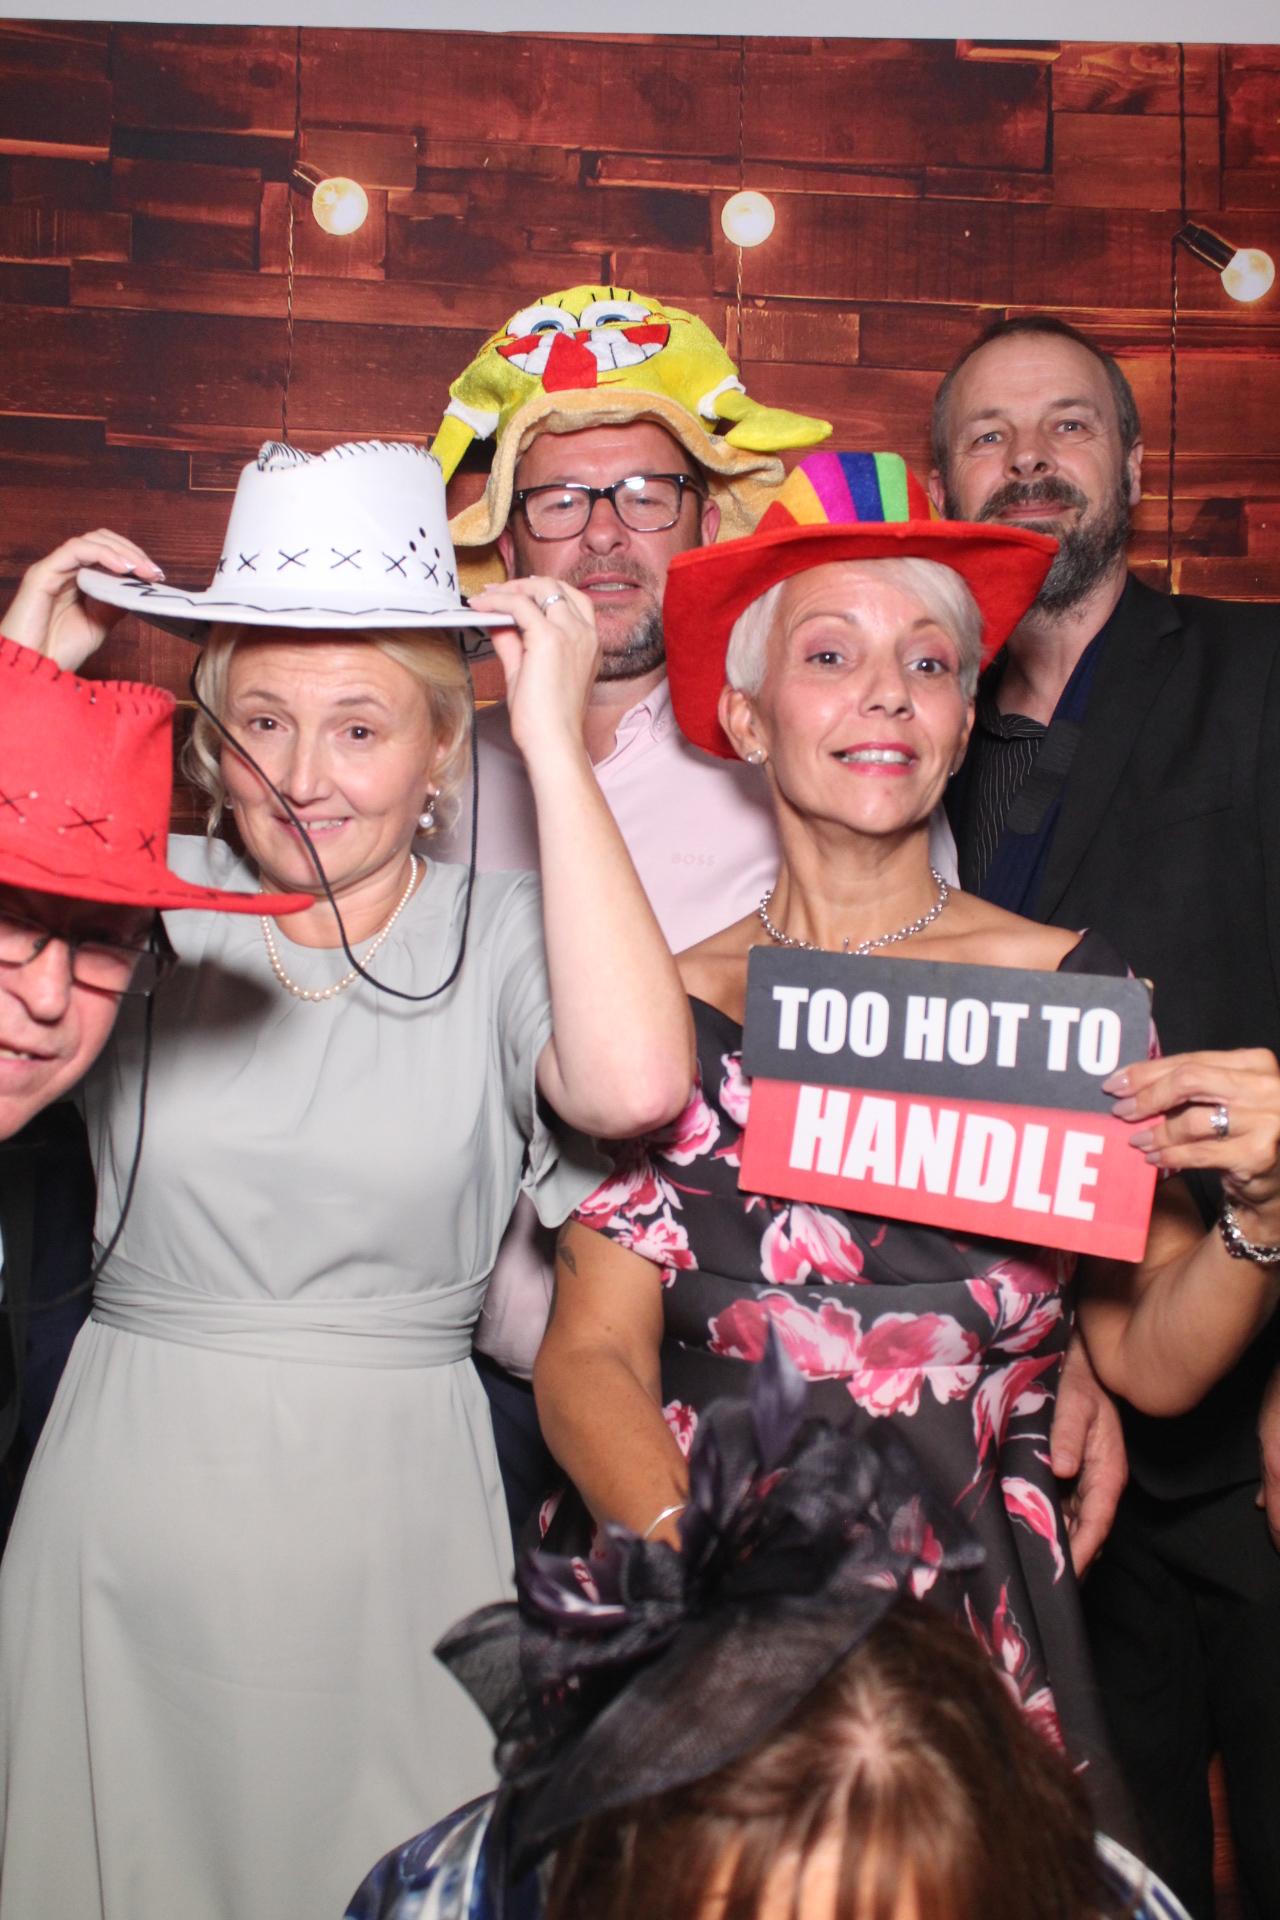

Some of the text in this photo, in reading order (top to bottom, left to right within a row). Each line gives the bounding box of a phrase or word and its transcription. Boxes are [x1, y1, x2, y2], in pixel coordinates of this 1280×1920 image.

[671, 853, 716, 867] BOSS
[772, 985, 1122, 1076] TOO HOT TO
[788, 1085, 1106, 1221] HANDLE
